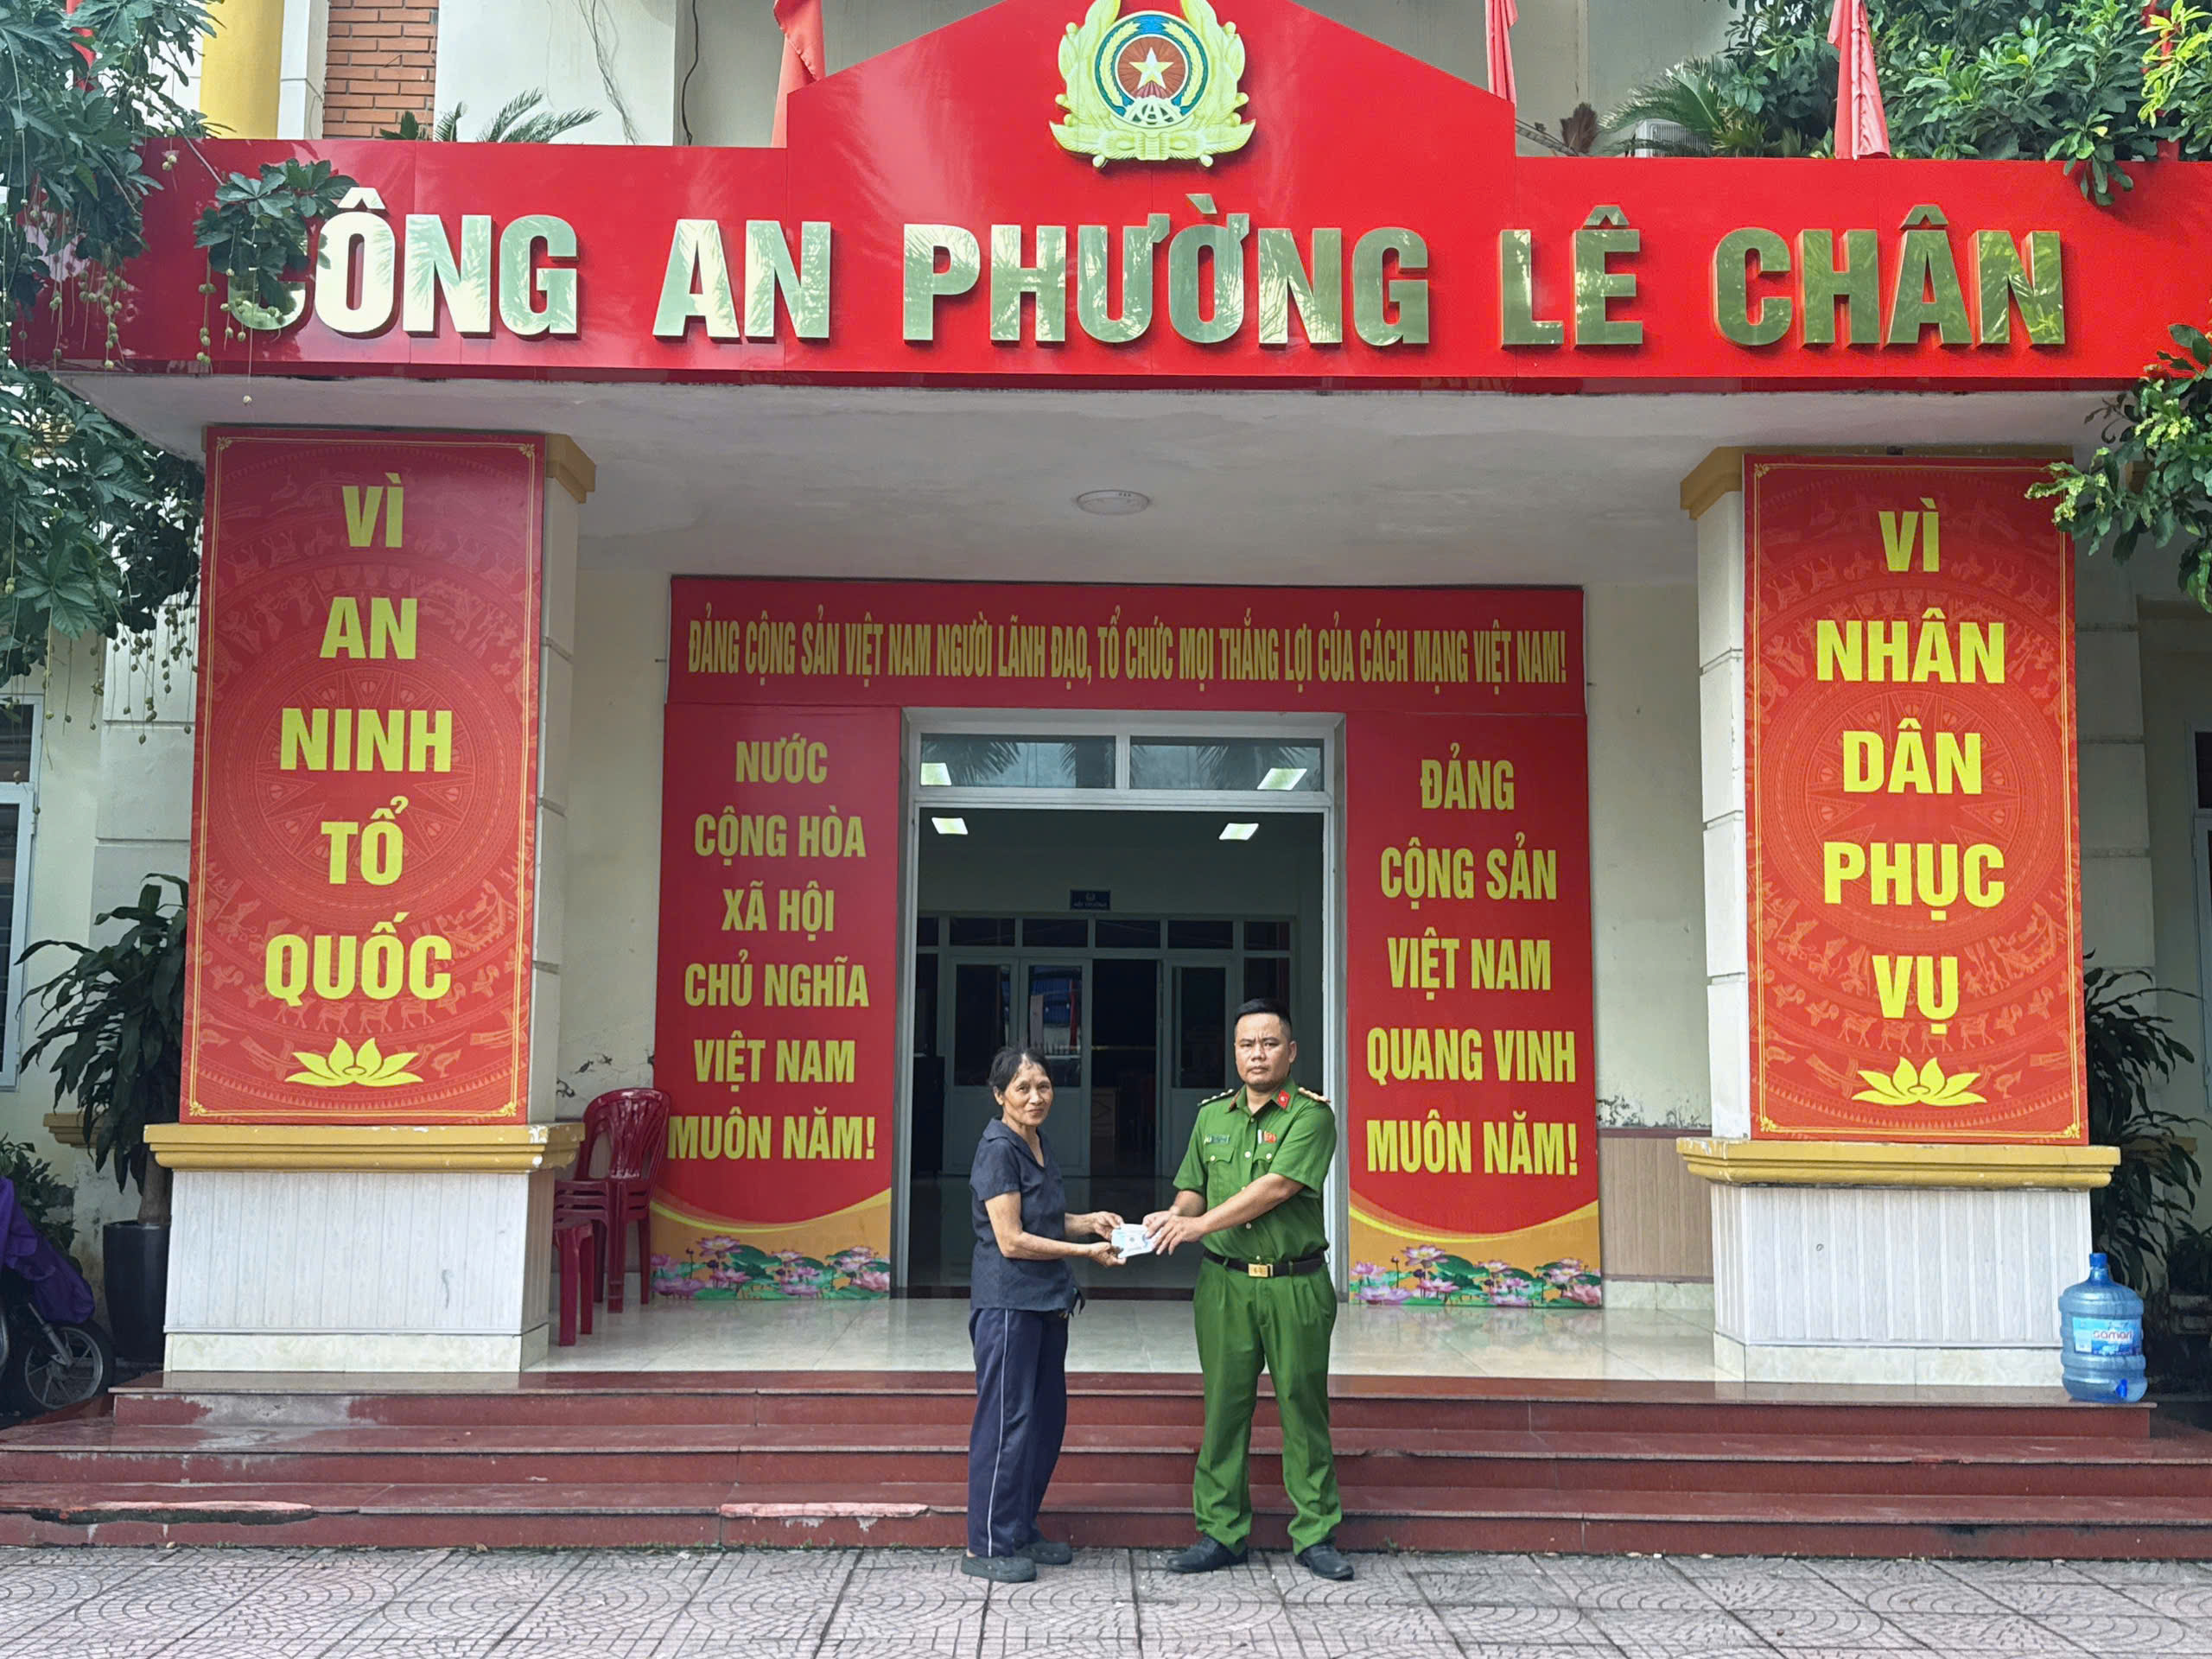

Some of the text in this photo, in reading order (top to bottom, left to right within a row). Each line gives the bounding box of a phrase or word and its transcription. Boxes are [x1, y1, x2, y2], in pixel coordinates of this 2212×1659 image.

[652, 219, 832, 340] AN
[902, 193, 1430, 347] PHƯỜNG
[1499, 205, 1643, 346] LÊ
[1712, 204, 2066, 347] CHÂN
[342, 472, 404, 548] VÌ
[1878, 497, 1940, 573] VÌ
[319, 596, 418, 660] AN
[689, 602, 1567, 695] ĐẢNG CỘNG SẢN VIỆT NAM NGƯỜI LÃNH ĐẠO, TỔ CHỨC MỌI THẮNG LỢI CỦA CÁCH MẠNG VIỆT NAM!
[1816, 607, 2005, 684] NHÂN
[279, 708, 453, 772] NINH
[735, 733, 828, 784] NƯỚC
[1420, 742, 1515, 810] ĐẢNG
[1842, 718, 1982, 795] DÂN
[321, 796, 410, 887] TỔ
[694, 804, 867, 866] CỘNG HÒA
[1380, 831, 1557, 910] CỘNG SẢN
[721, 880, 835, 942] XÃ HỘI
[1823, 842, 2005, 921] PHỤC
[264, 912, 453, 1007] QUỐC
[684, 949, 869, 1007] CHỦ NGHĨA
[1387, 926, 1551, 1001] VIỆT NAM
[1872, 955, 1959, 1034] VỤ
[694, 1030, 855, 1093] VIỆT NAM
[1366, 1027, 1576, 1086] QUANG VINH
[667, 1106, 875, 1160] MUÔN NĂM!
[1366, 1109, 1578, 1176] MUÔN NĂM!
